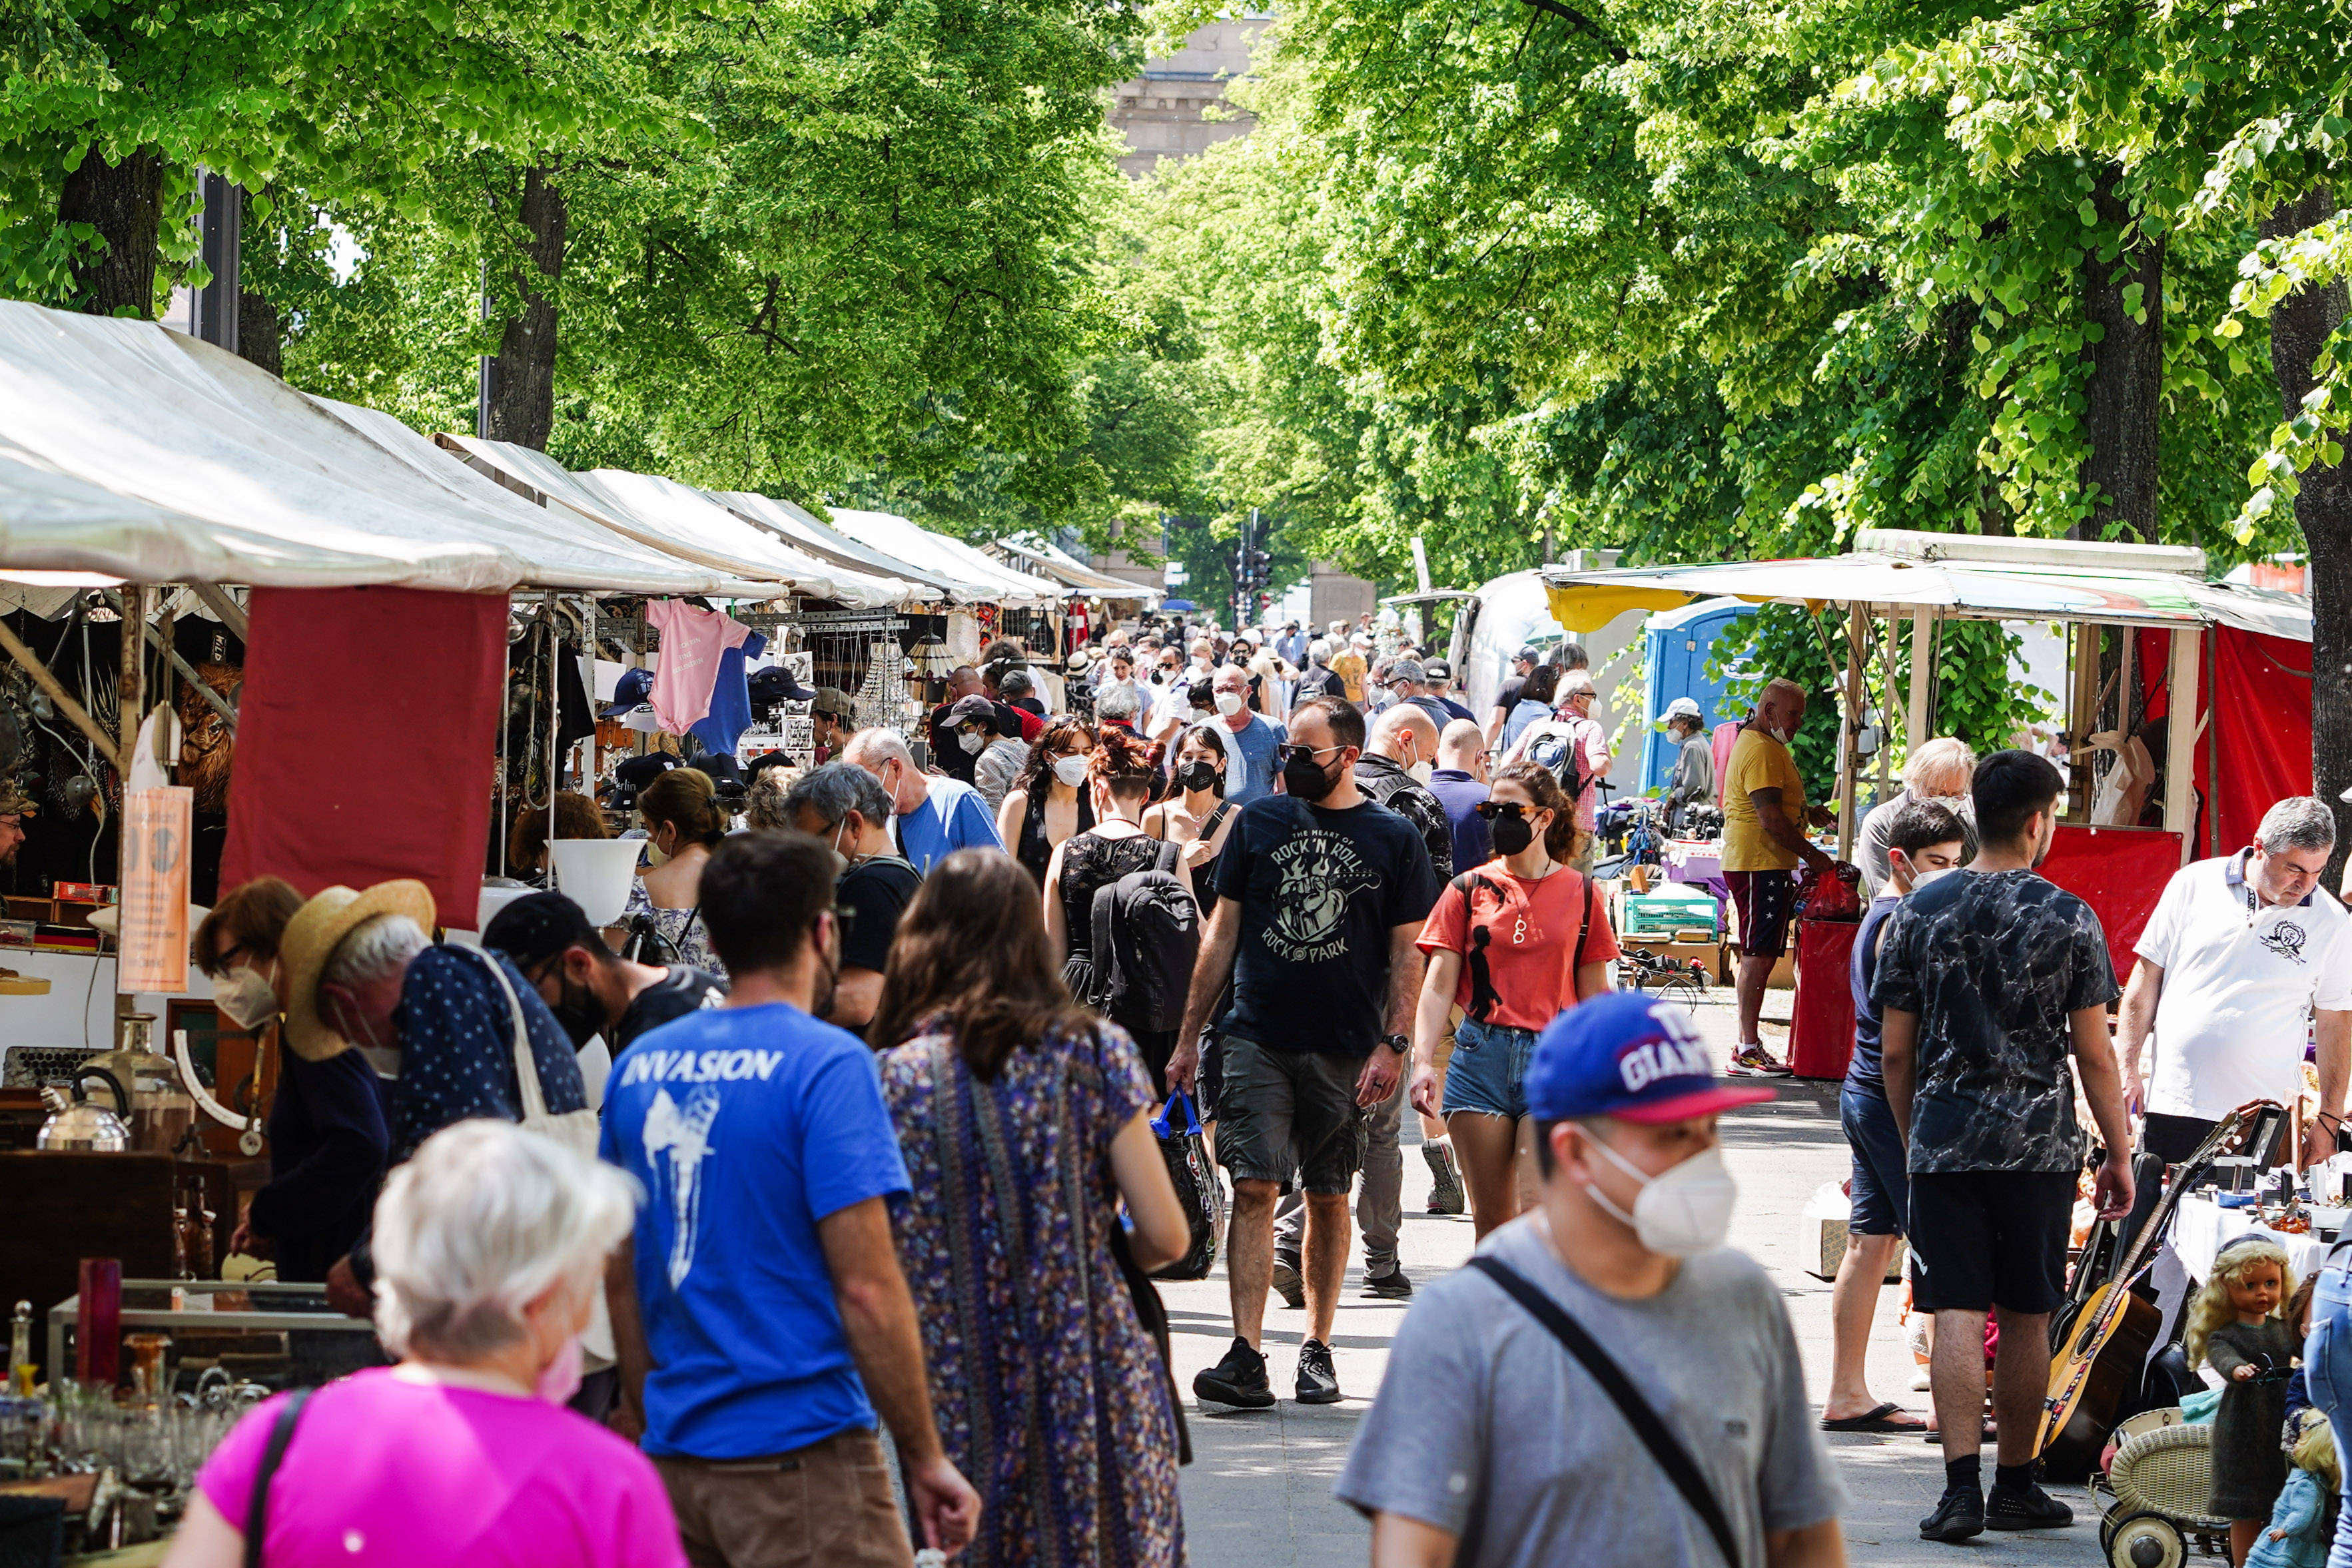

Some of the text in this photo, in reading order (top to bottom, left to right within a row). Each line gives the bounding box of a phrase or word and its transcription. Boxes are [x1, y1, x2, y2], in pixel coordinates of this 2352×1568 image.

[214, 634, 225, 661] WILD
[1292, 829, 1354, 845] THE HEART OF
[1270, 838, 1310, 865] ROCK
[1330, 842, 1363, 873] ROLL
[1262, 927, 1349, 963] ROCK PARK
[619, 1048, 785, 1087] INVASION
